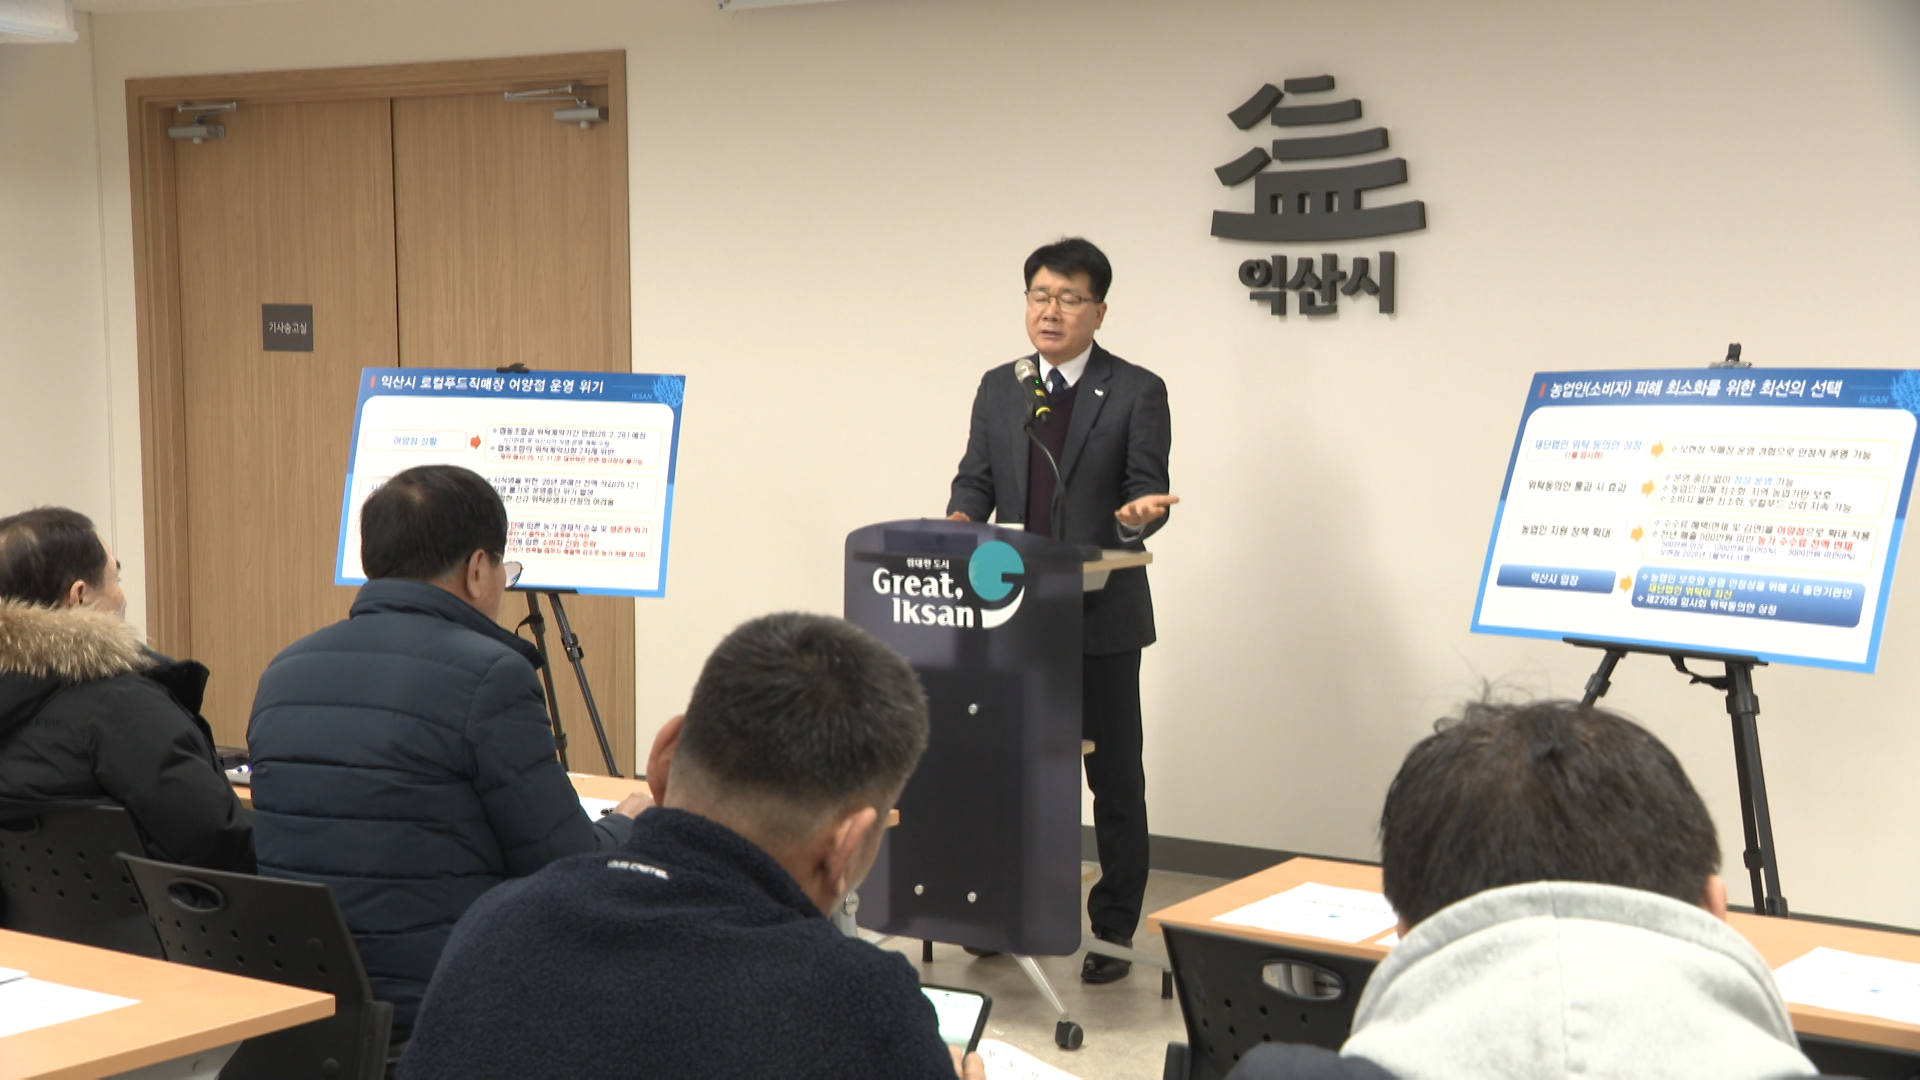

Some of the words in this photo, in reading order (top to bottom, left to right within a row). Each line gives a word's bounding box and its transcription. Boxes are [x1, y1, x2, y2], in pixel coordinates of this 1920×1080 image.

[1239, 251, 1395, 316] 익산시
[268, 321, 307, 336] 기사송고실
[381, 375, 416, 390] 익산시
[420, 375, 505, 392] 로컬푸드직매장
[509, 377, 546, 393] 어양점
[550, 379, 575, 394] 운영
[579, 379, 604, 394] 위기
[1550, 380, 1632, 399] 농업인(소비자)
[1634, 379, 1664, 397] 피해
[1665, 379, 1721, 398] 최소화를
[1725, 379, 1757, 397] 위한
[1759, 379, 1807, 398] 최선의
[1810, 379, 1844, 398] 선택
[1858, 395, 1889, 404] IKSAN
[933, 559, 950, 570] 도시
[872, 567, 963, 600] Great,
[892, 597, 974, 628] Iksan
